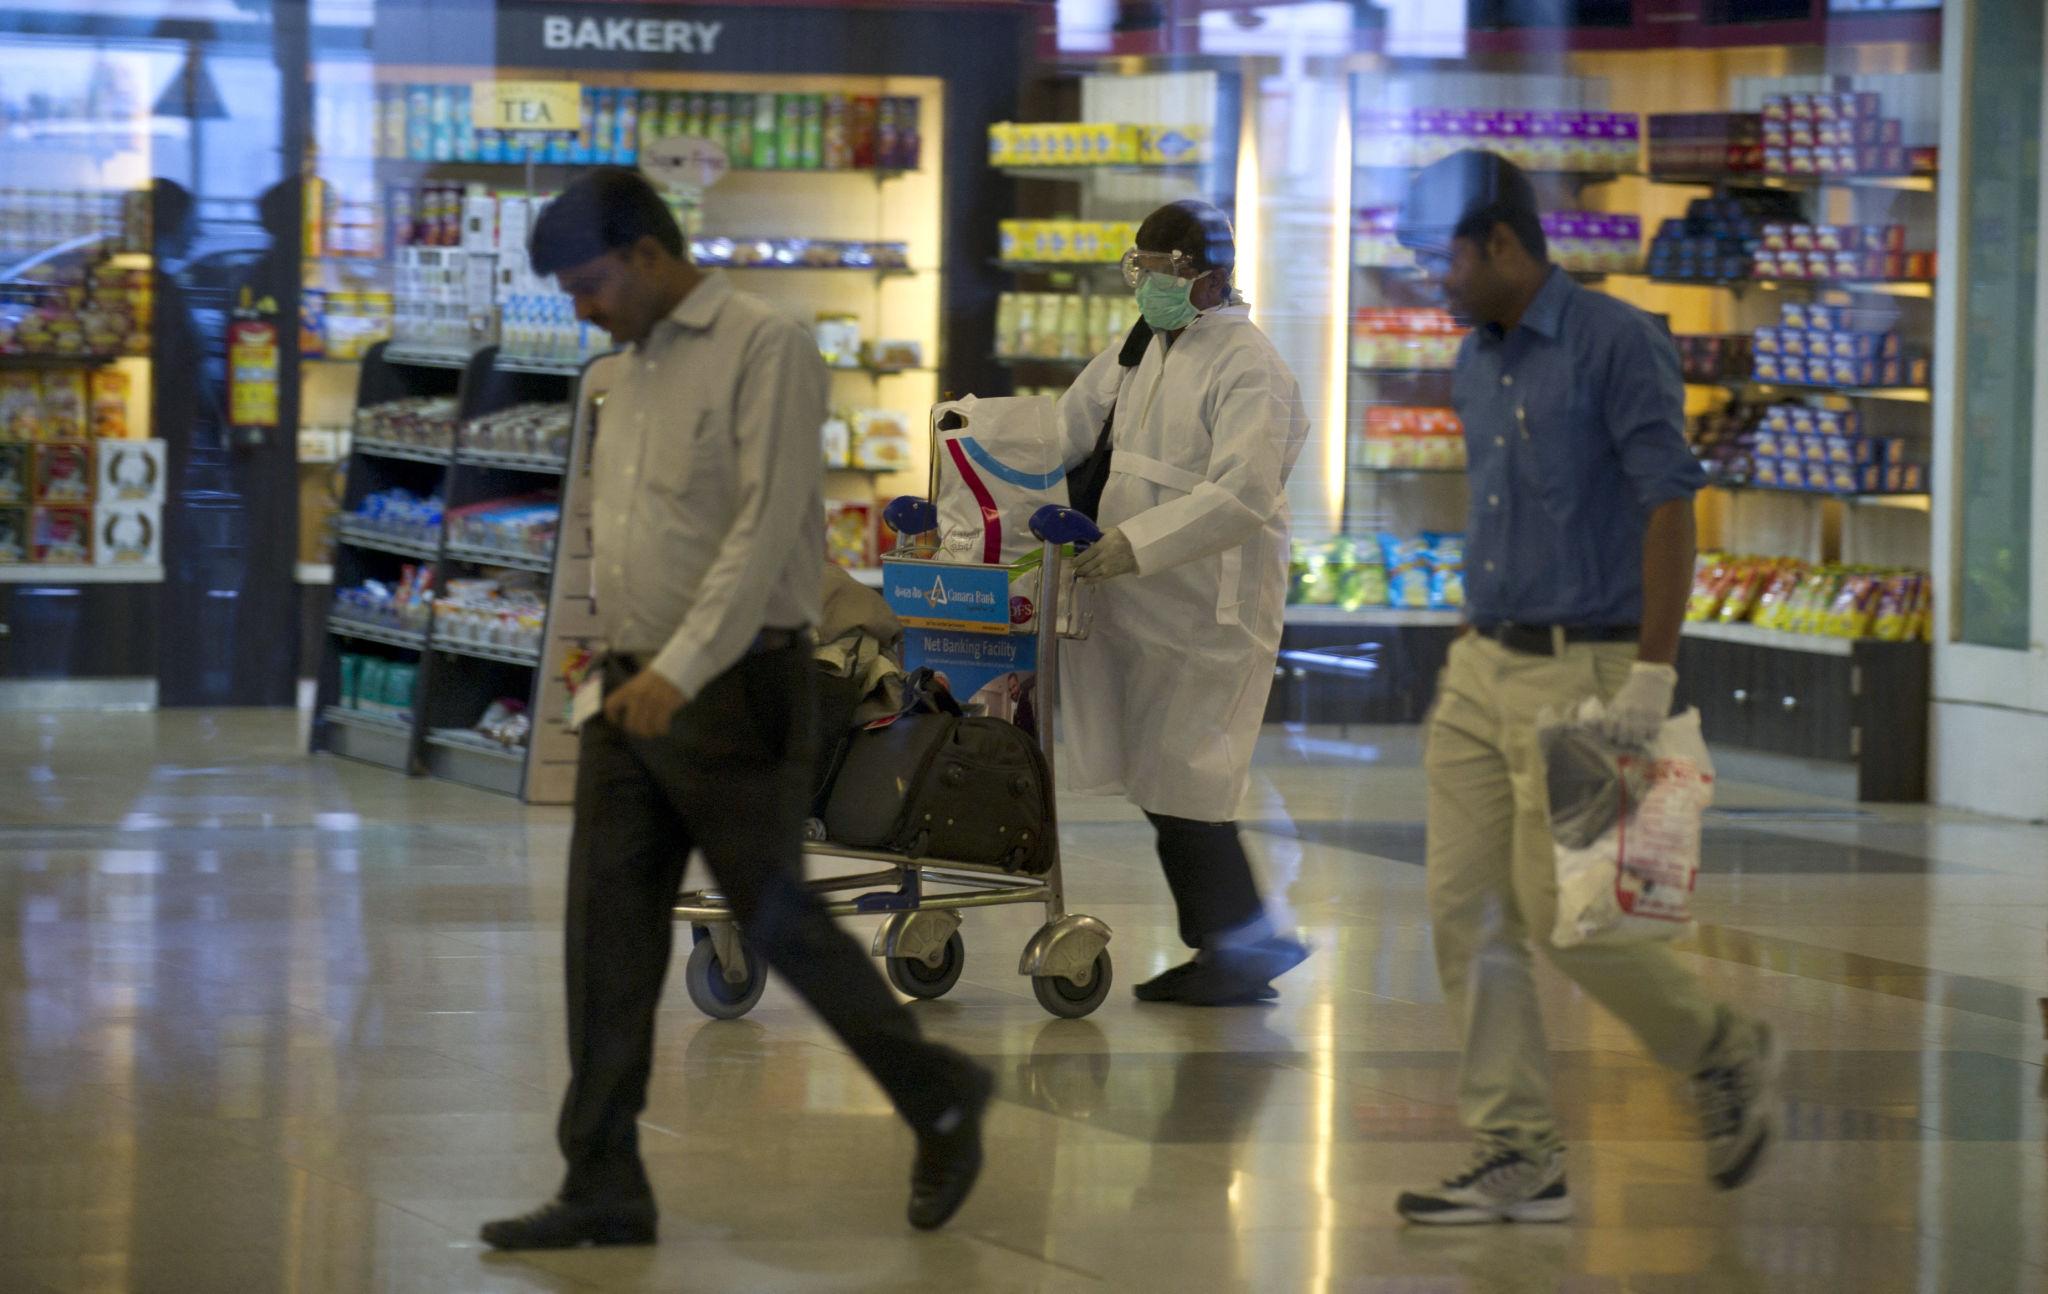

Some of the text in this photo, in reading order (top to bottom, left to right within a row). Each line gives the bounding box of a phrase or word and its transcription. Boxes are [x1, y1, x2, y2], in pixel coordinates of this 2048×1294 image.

[543, 15, 722, 54] BAKERY
[502, 100, 554, 123] TEA
[947, 588, 996, 605] Canara Bank
[923, 636, 1017, 662] Net Banking Facility
